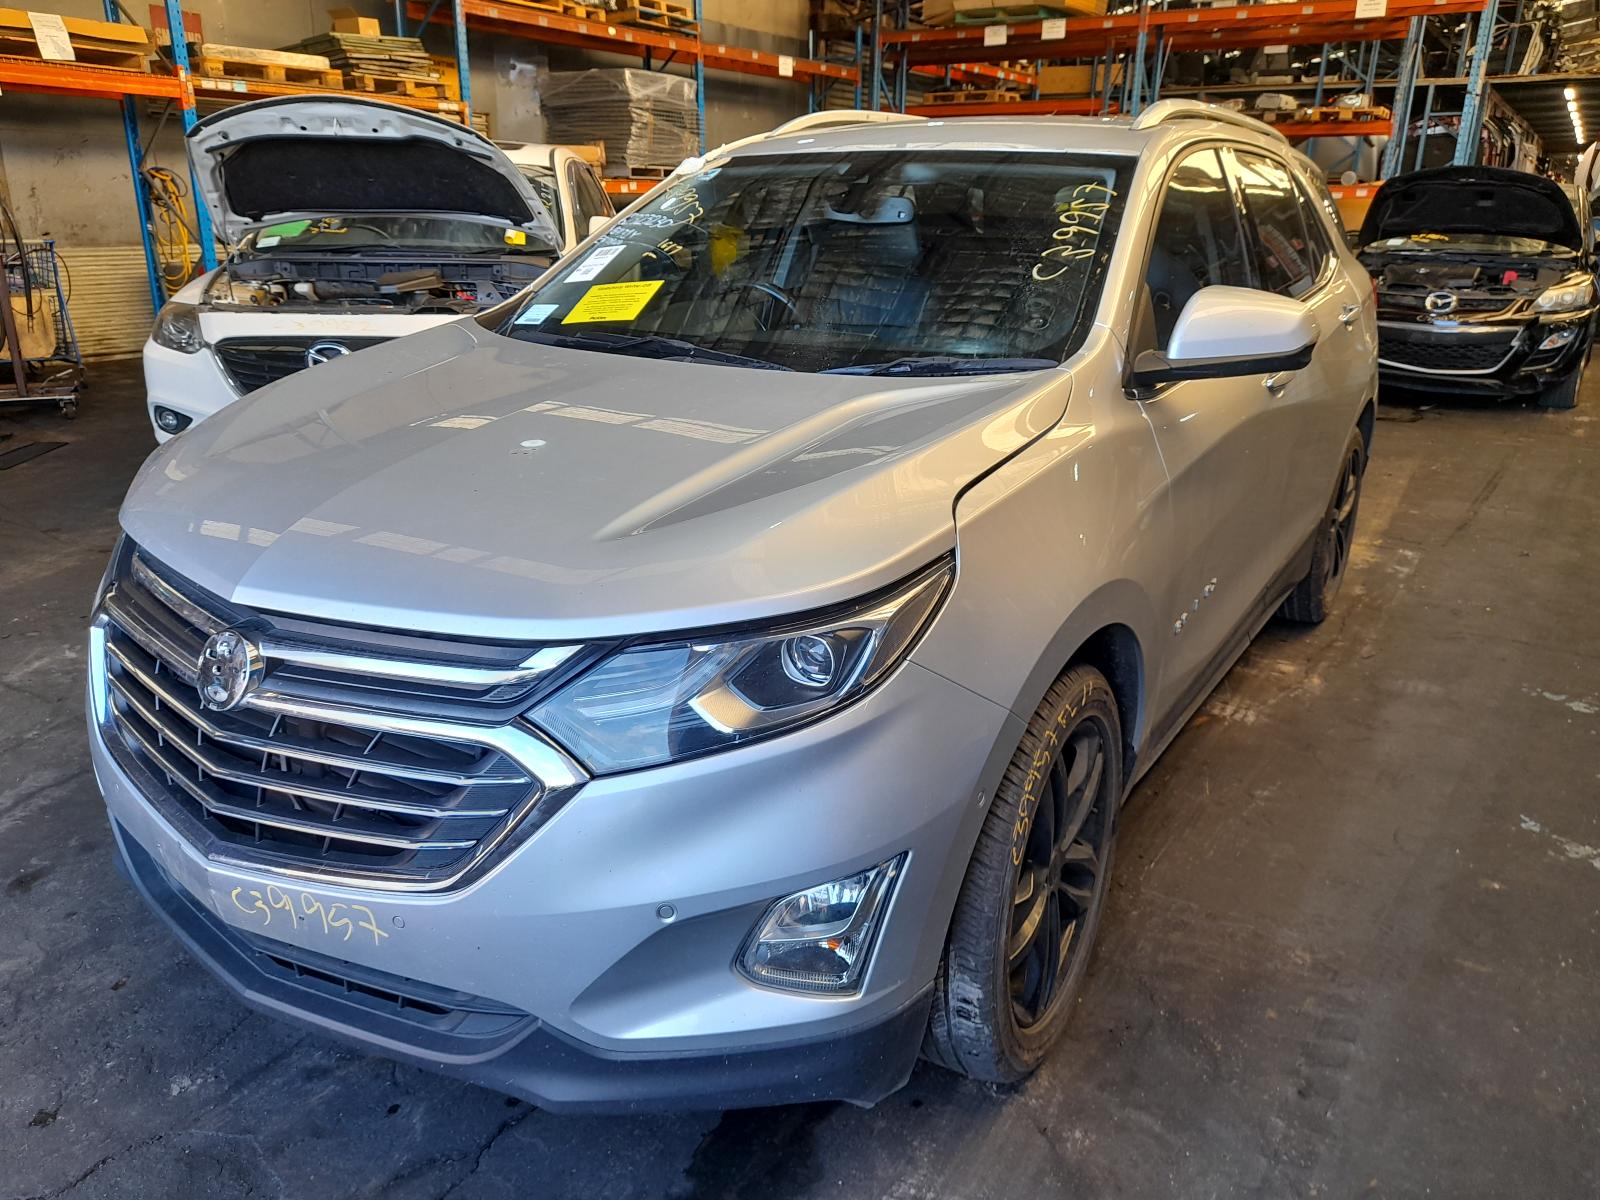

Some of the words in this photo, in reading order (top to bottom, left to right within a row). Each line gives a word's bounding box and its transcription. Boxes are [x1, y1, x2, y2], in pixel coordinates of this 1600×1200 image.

[1031, 182, 1118, 281] C39957
[1011, 728, 1058, 866] C39957
[231, 885, 389, 946] C39957
